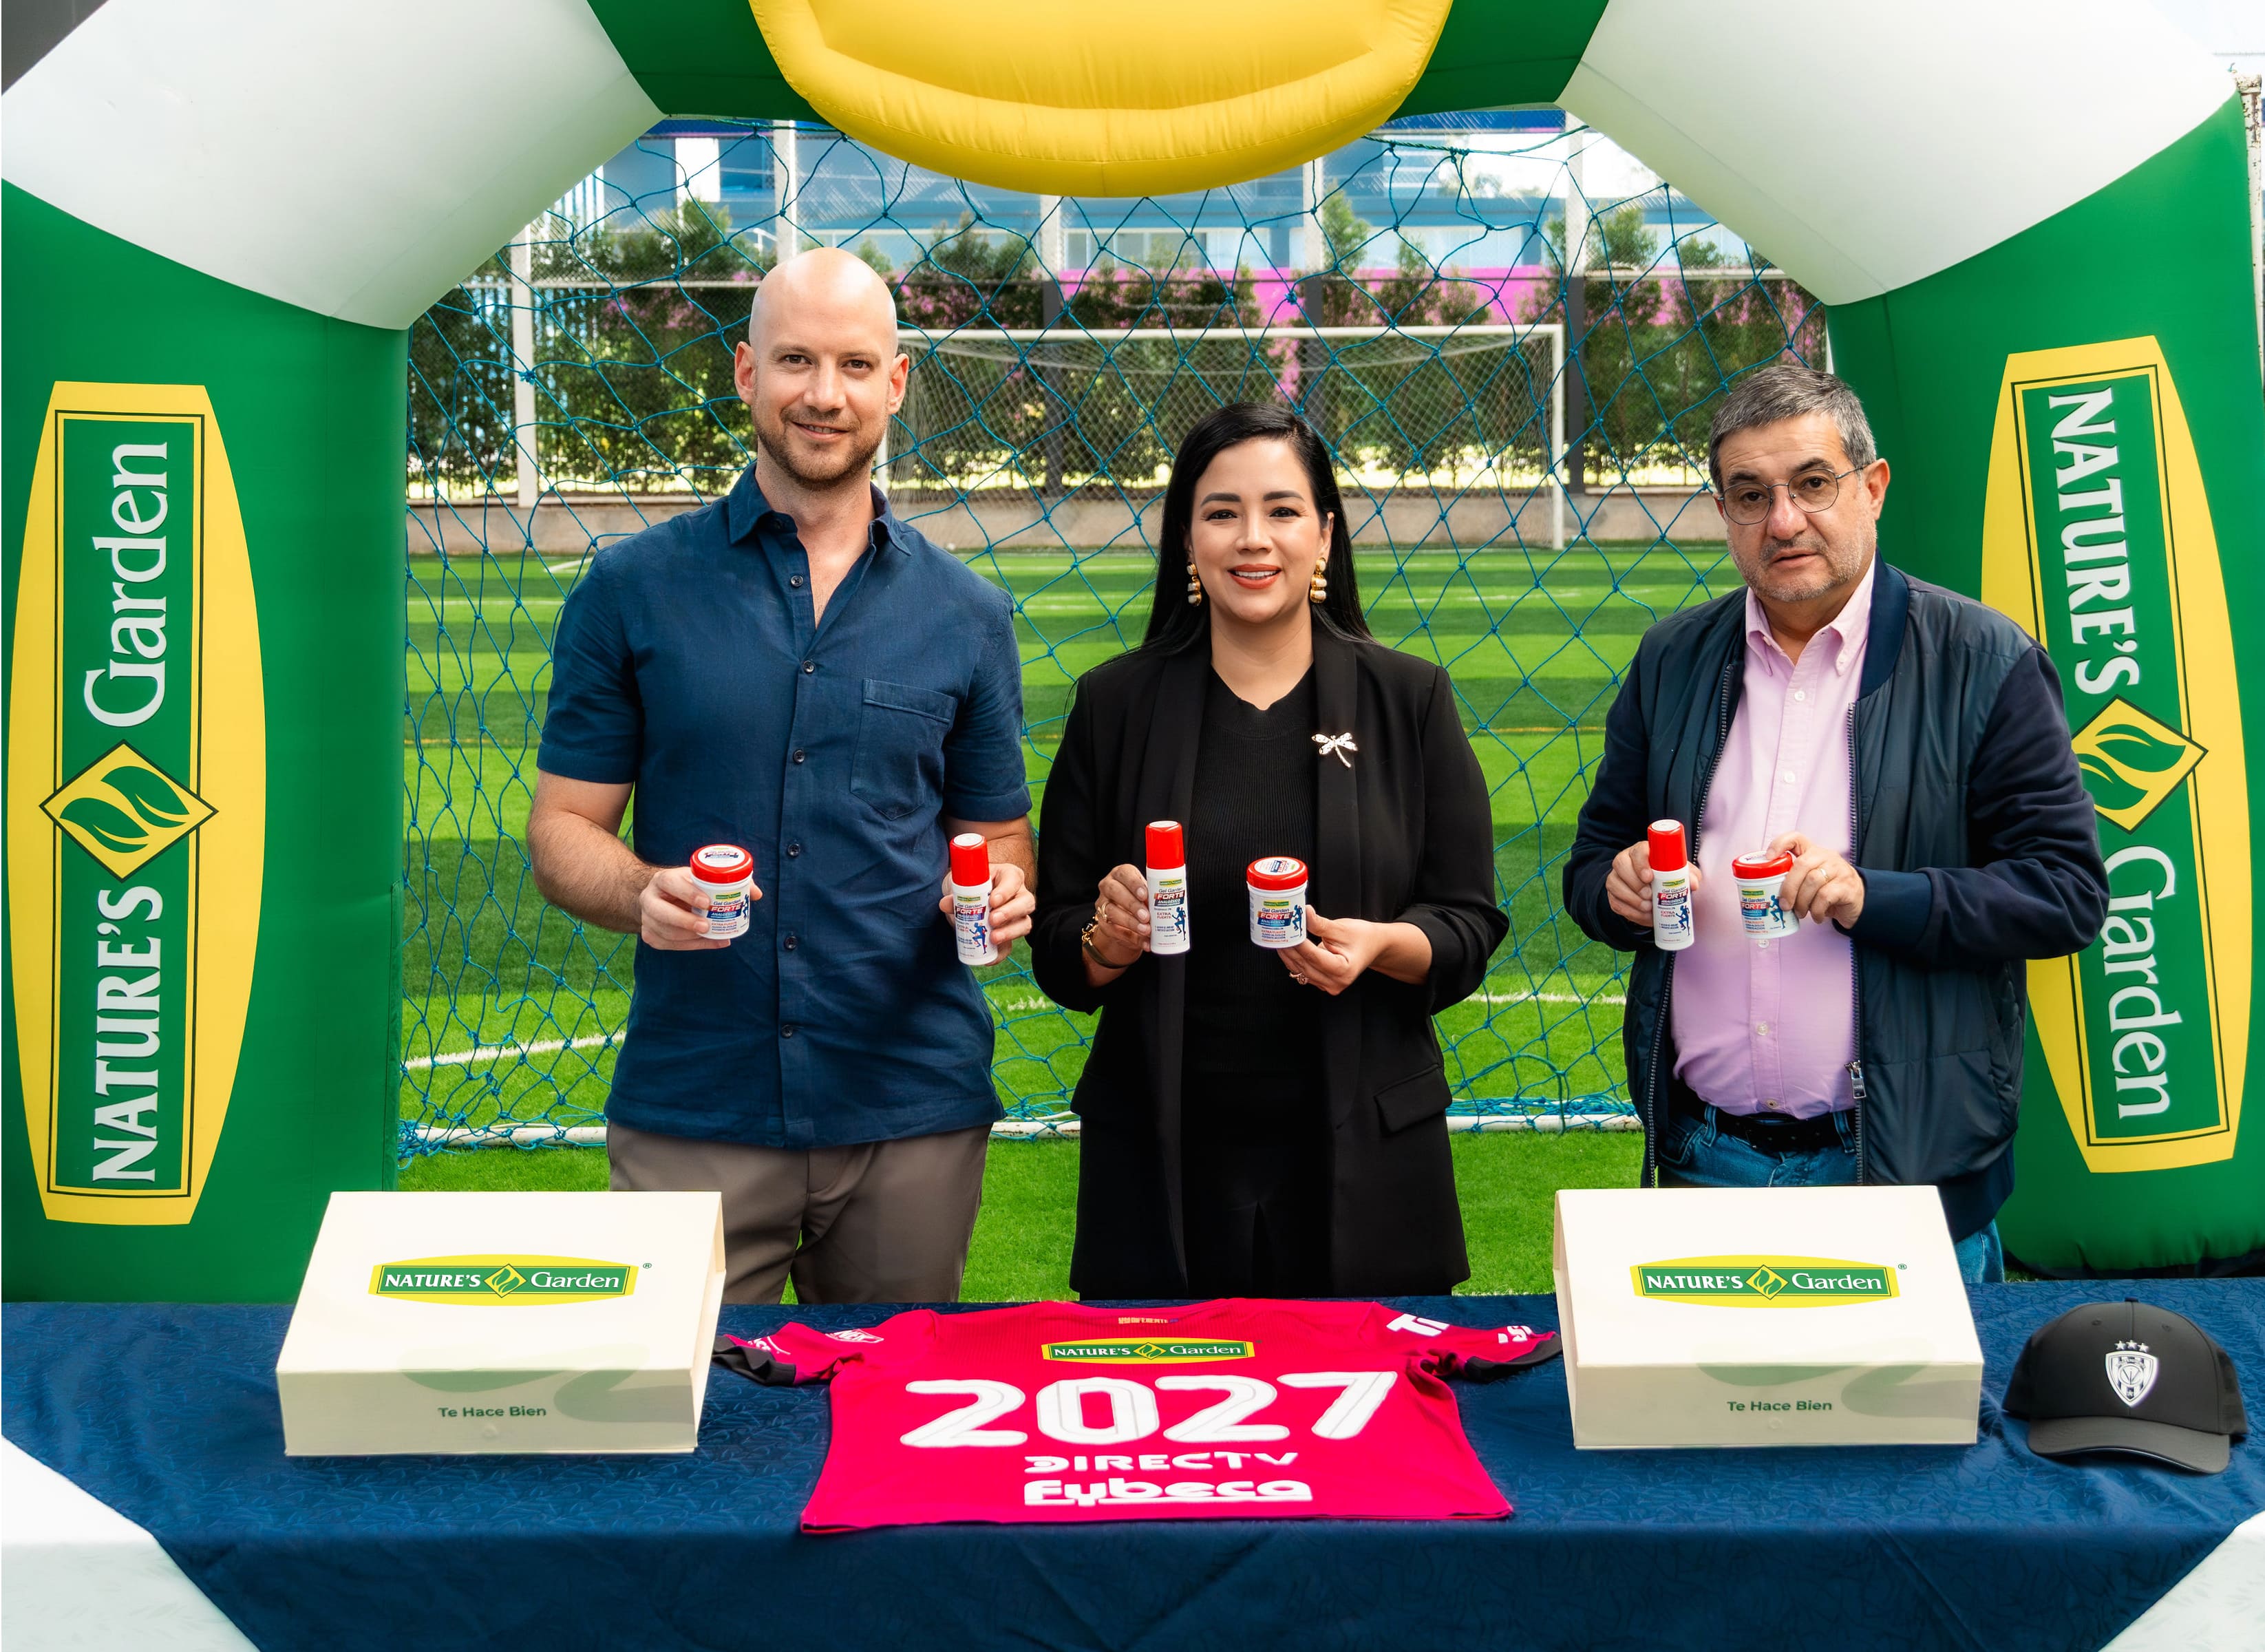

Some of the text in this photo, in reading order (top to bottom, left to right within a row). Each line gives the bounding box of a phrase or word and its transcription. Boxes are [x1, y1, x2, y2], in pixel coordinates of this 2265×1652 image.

[2048, 386, 2182, 1119] NATURE'S Garden
[84, 442, 167, 1183] NATURE'S Garden
[1158, 891, 1184, 900] FORTE
[1661, 890, 1687, 899] FORTE
[711, 904, 741, 913] FORTE
[957, 907, 983, 915] FORTE
[385, 1271, 619, 1289] NATURE'S Garden
[1646, 1273, 1882, 1290] NATURE'S Garden
[1054, 1345, 1241, 1356] NATURE'S Garden
[438, 1406, 546, 1417] Te Hace Bien
[900, 1371, 1398, 1448] 2027
[1727, 1400, 1832, 1411] Te Hace Bien
[1024, 1452, 1298, 1473] DIRECTV
[1024, 1477, 1312, 1506] Fybeca
